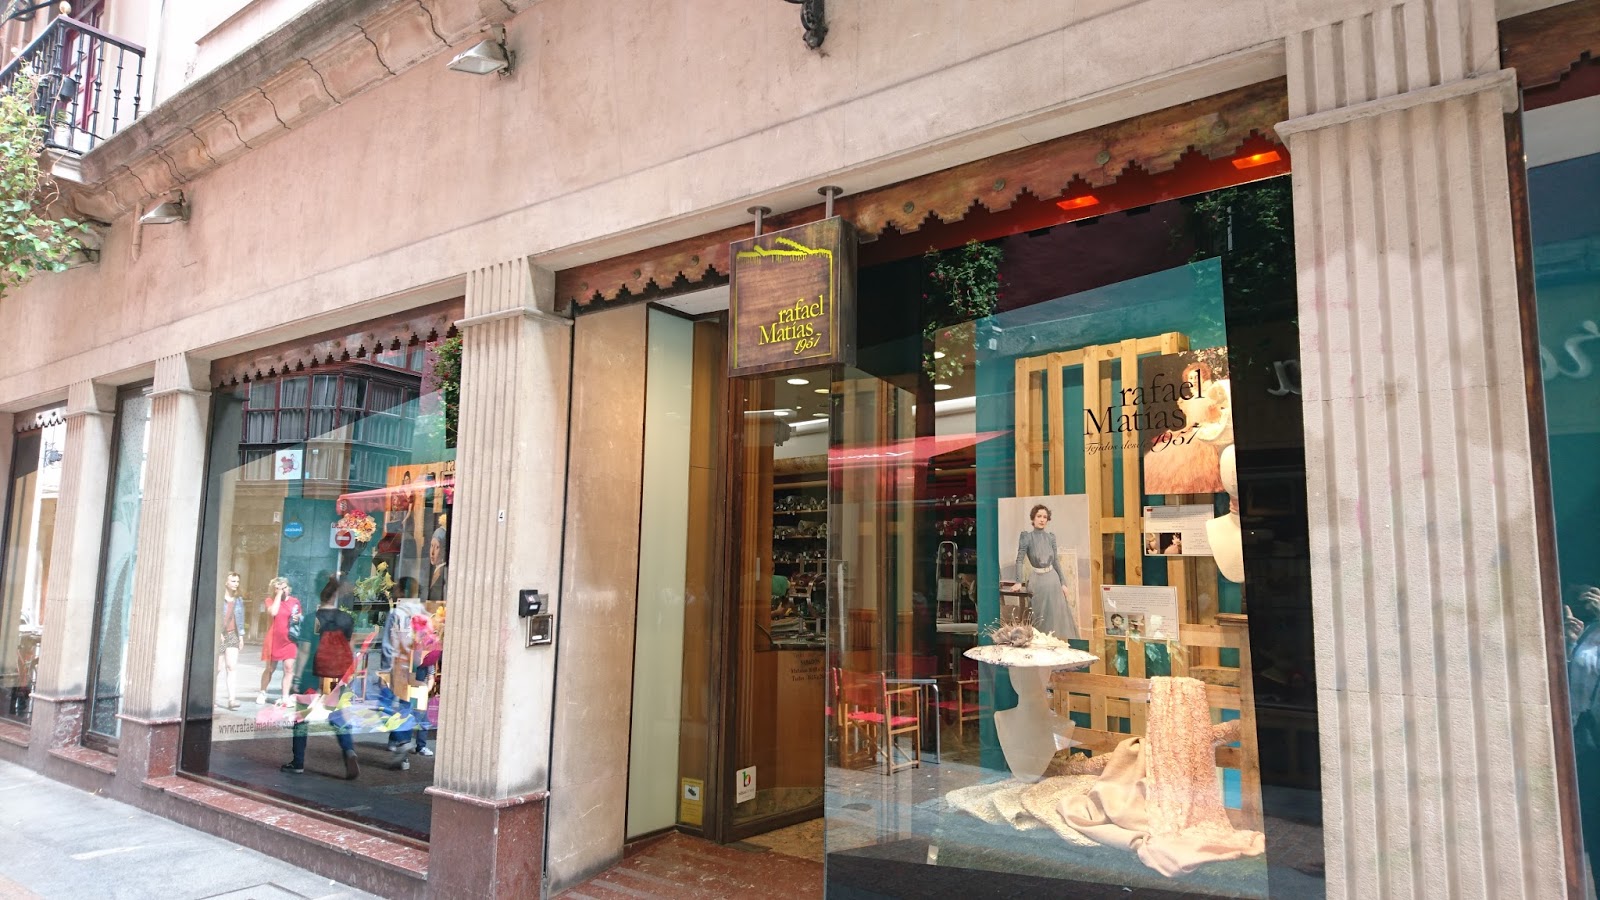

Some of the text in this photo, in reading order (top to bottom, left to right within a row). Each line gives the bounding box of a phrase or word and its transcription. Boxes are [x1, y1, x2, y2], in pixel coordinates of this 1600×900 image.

[778, 294, 825, 324] rafael
[758, 321, 814, 346] Matías
[794, 333, 822, 355] 1957
[1119, 368, 1205, 407] rafael
[1083, 405, 1186, 436] Matías
[1150, 423, 1200, 453] 1957
